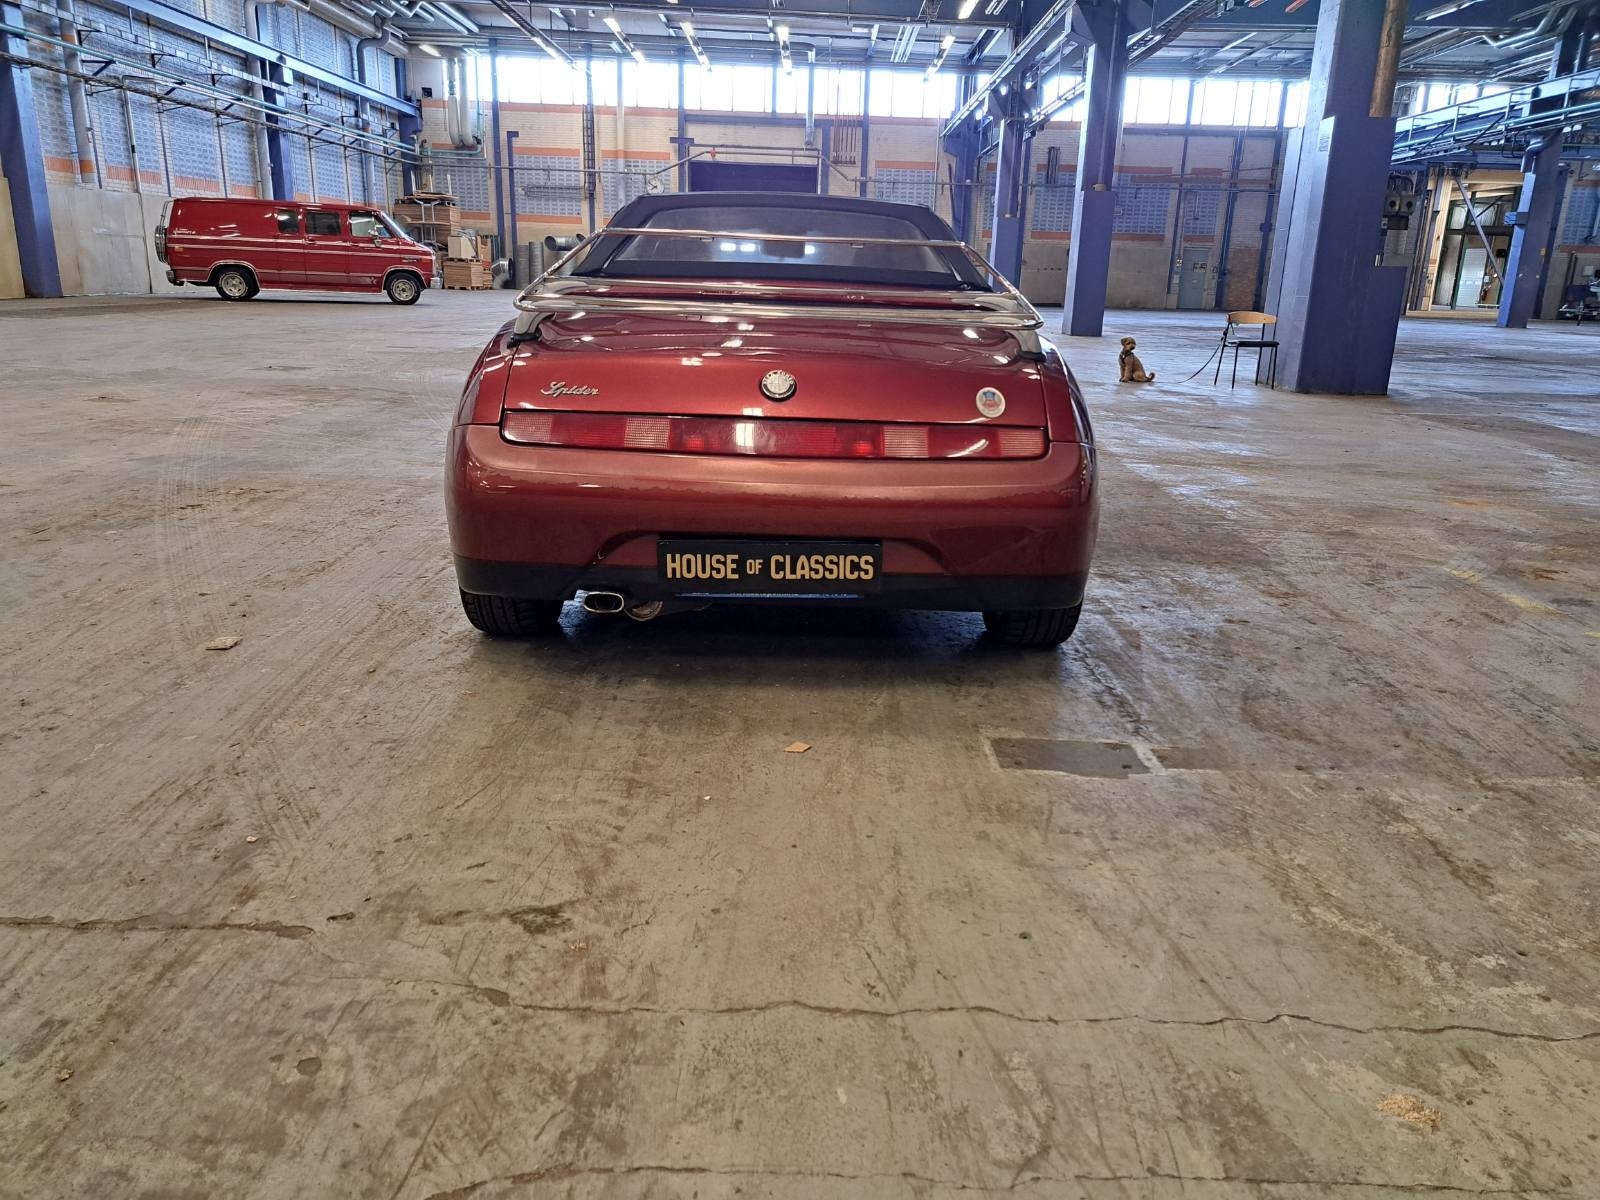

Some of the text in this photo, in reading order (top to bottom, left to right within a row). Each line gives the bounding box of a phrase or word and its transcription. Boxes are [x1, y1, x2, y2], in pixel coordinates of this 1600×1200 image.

[540, 381, 600, 398] Spider
[666, 553, 874, 580] HOUSE OF CLASSICS
